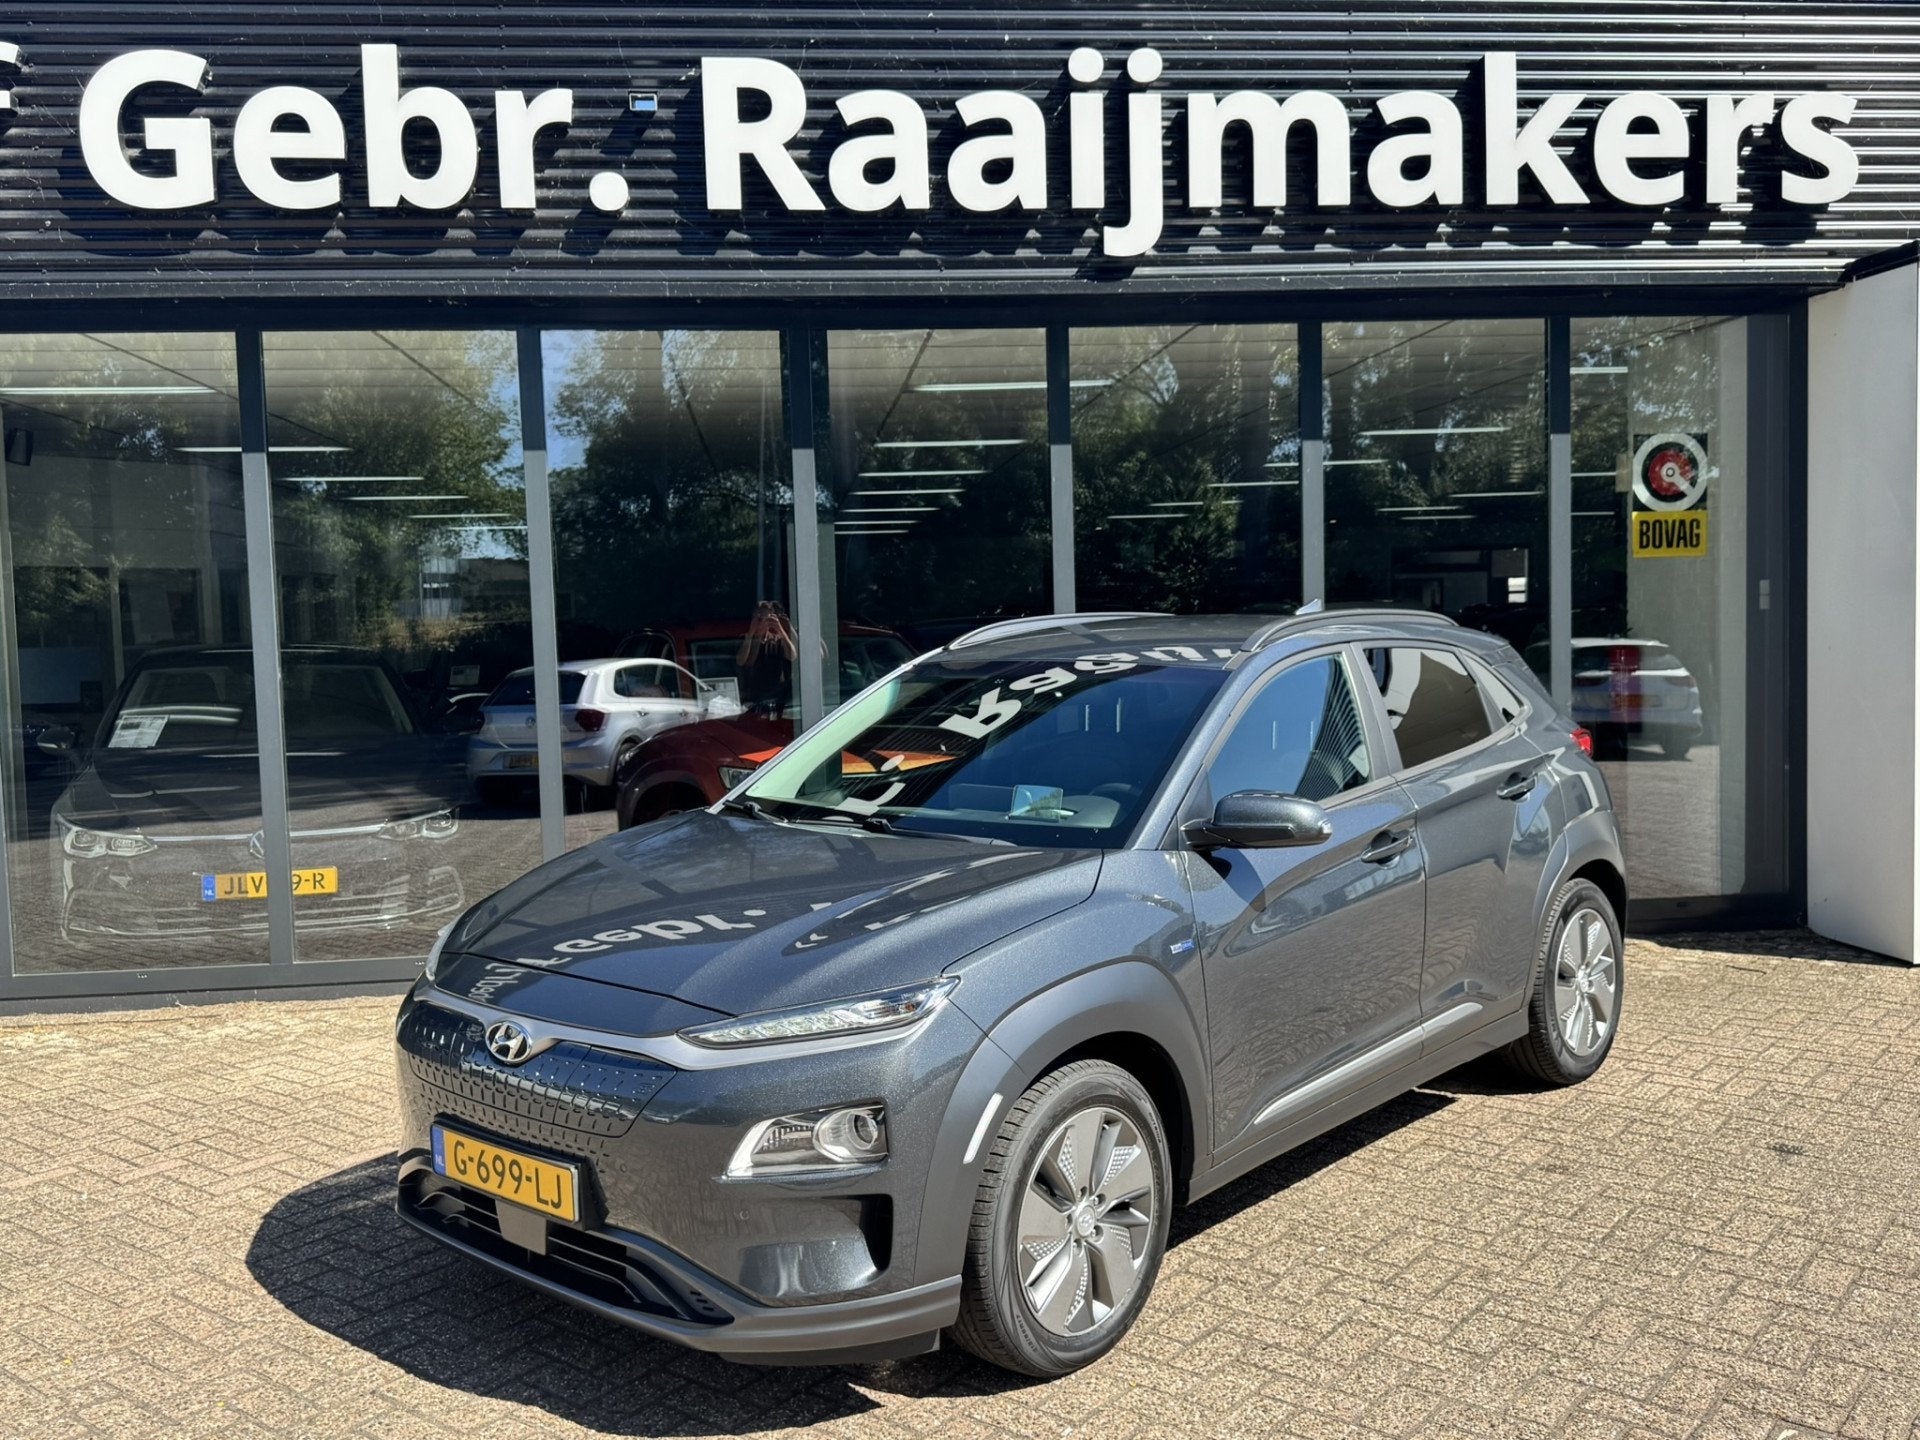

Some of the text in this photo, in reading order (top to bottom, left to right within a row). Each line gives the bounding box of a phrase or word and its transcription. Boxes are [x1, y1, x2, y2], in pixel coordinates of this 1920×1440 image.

[79, 43, 1861, 257] Gebr. Raaijmakers
[1638, 518, 1701, 550] BOVAG
[453, 1139, 563, 1210] G-699-LJ
